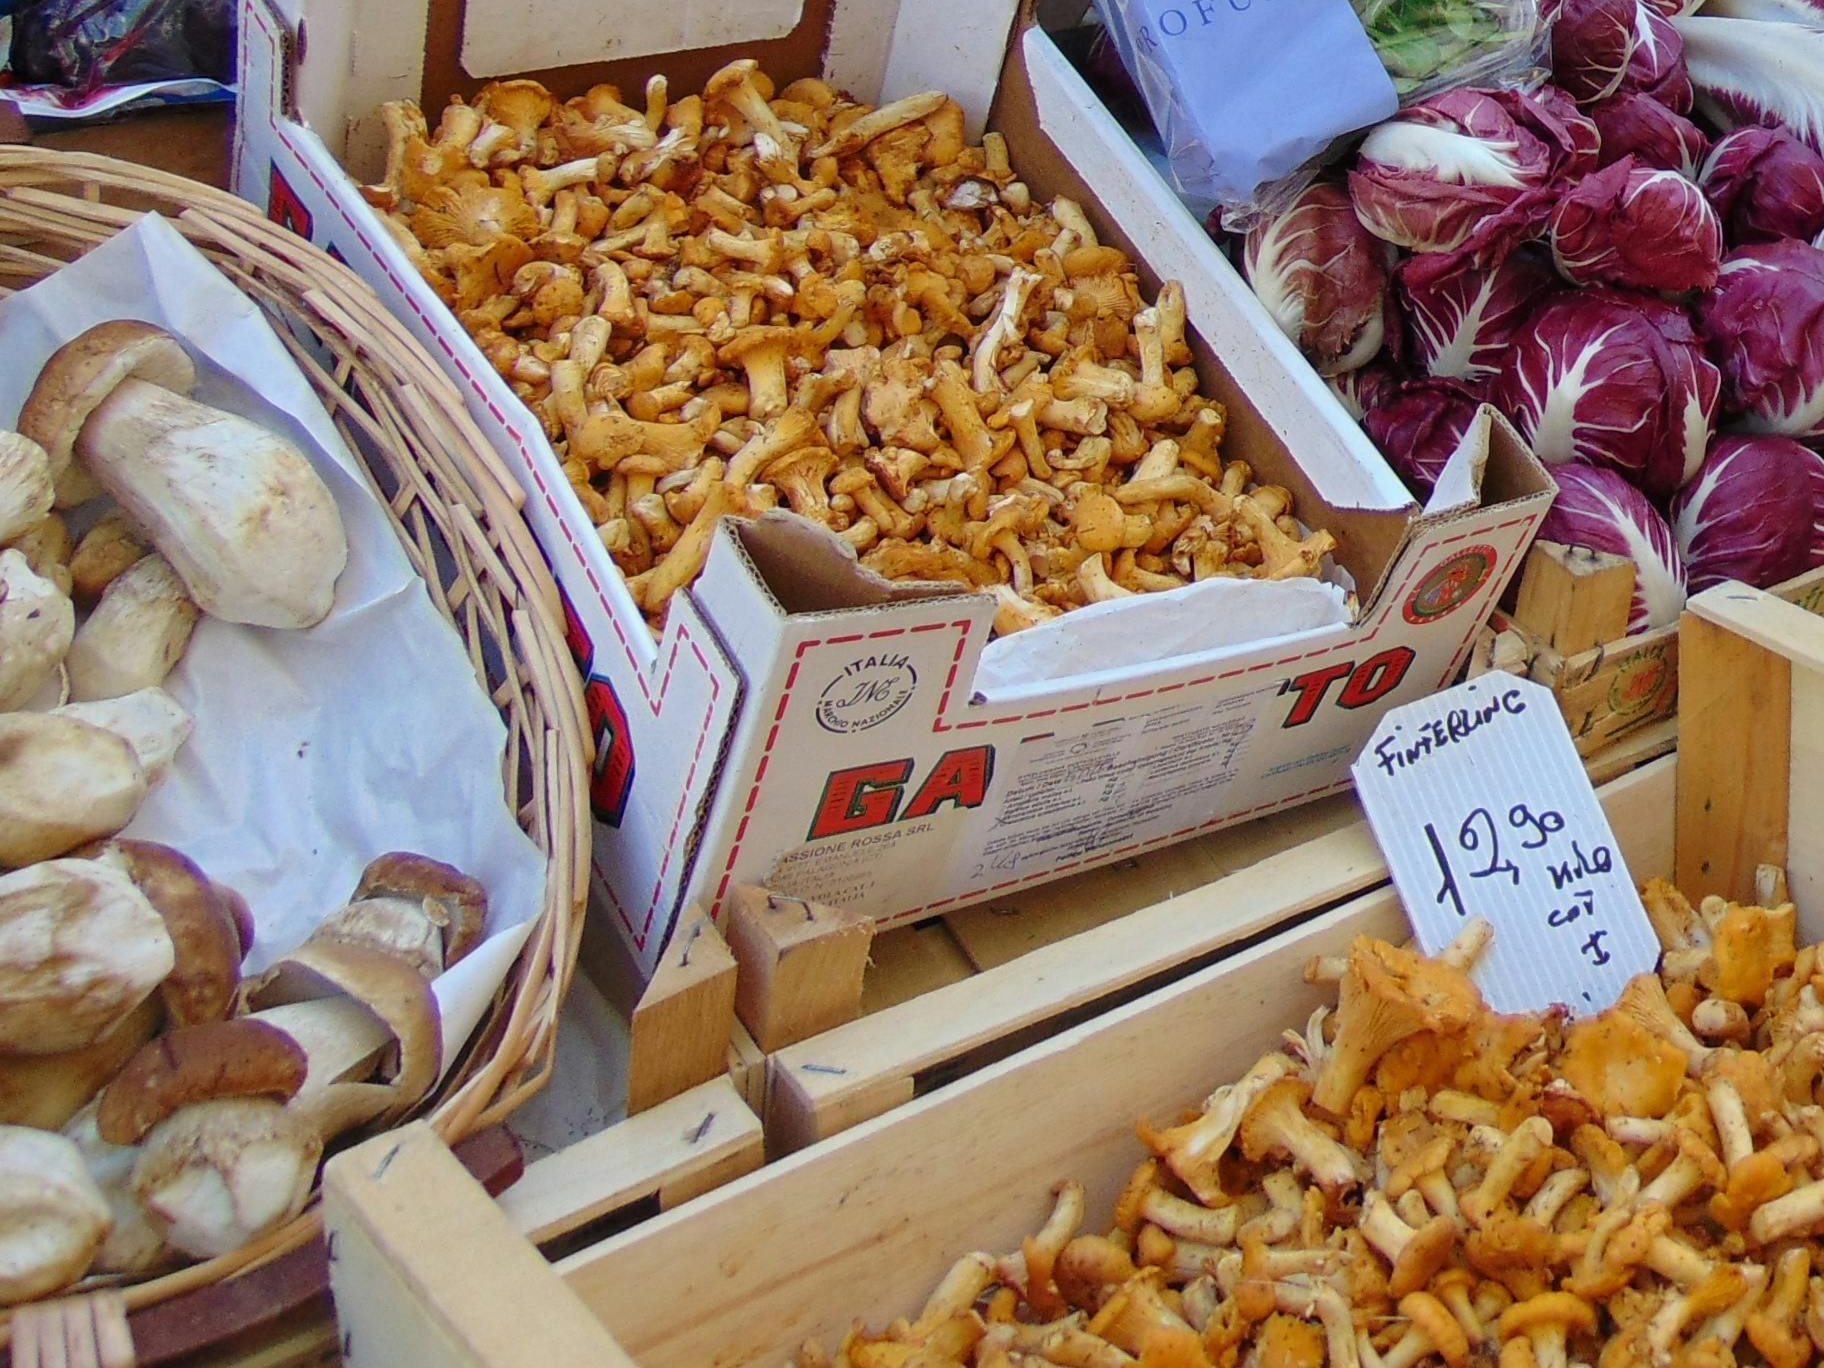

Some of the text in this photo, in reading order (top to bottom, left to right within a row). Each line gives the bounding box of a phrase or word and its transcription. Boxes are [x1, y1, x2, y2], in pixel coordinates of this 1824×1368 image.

[844, 653, 910, 677] ITALIA
[852, 688, 907, 729] NAZIONALE
[851, 829, 903, 850] ROSSA
